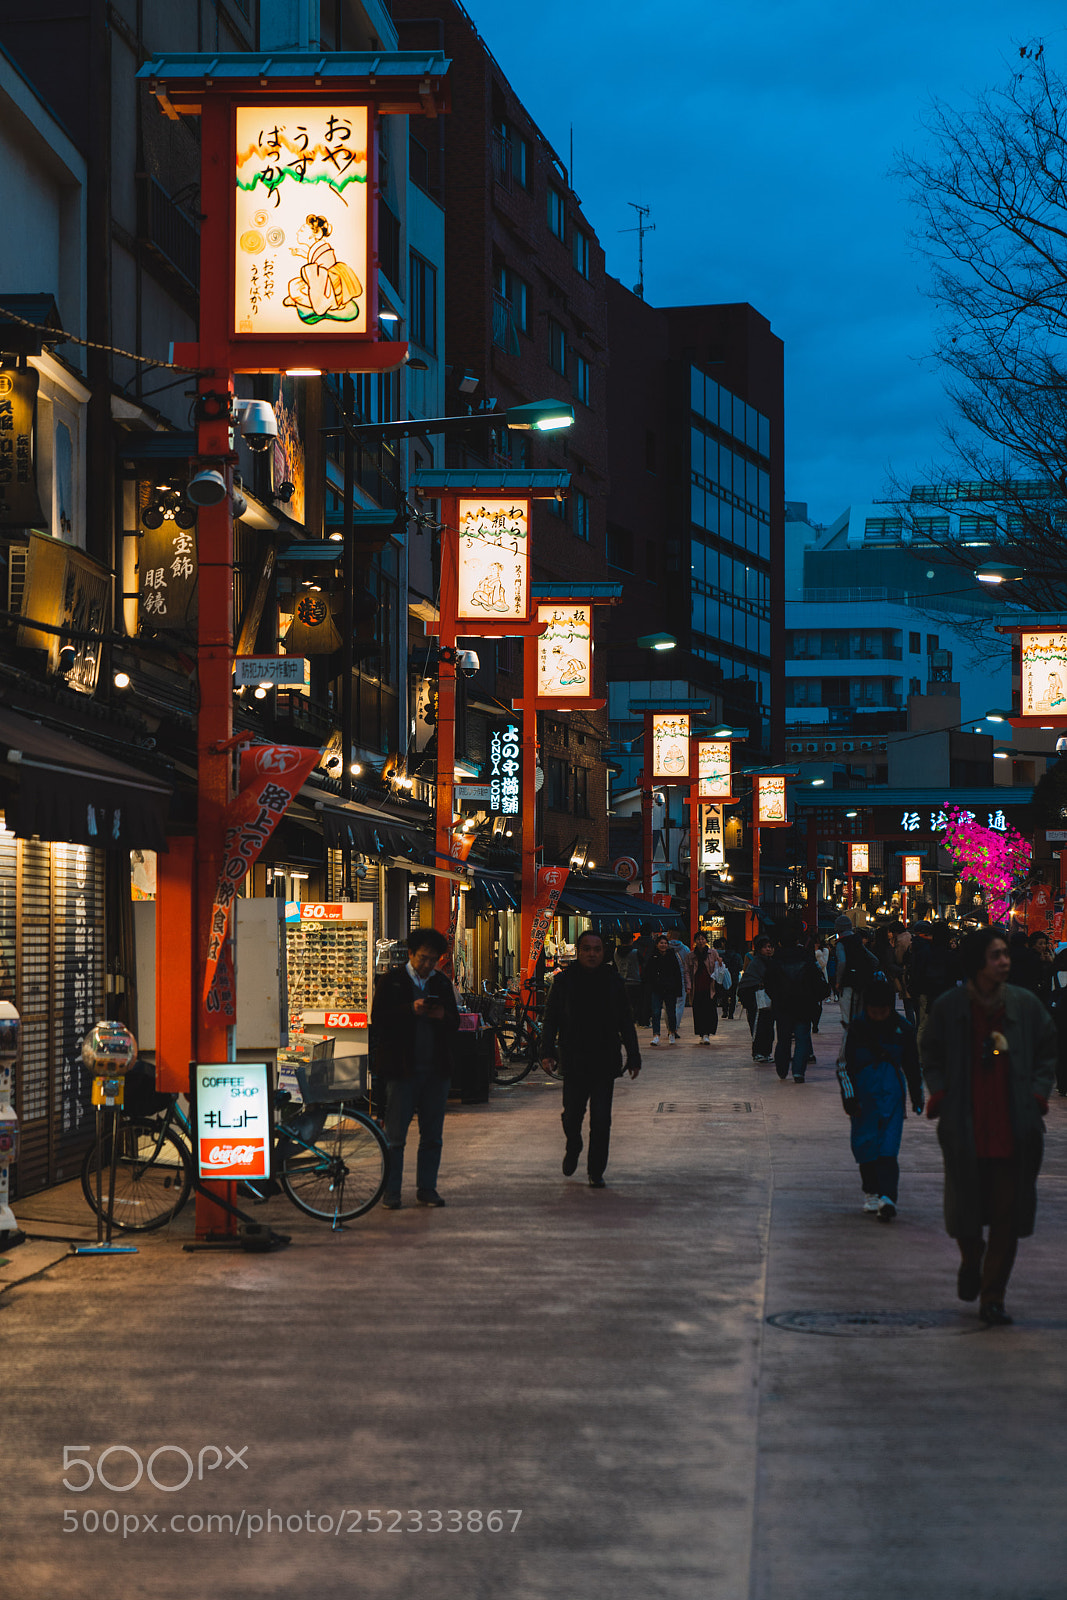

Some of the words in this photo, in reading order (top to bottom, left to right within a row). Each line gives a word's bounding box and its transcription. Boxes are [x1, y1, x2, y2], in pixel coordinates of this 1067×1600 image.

[258, 125, 286, 208] ばっかり
[249, 264, 262, 315] うそばかり
[509, 505, 524, 556] わらう
[170, 532, 194, 580] 宝飾
[143, 567, 168, 615] 眼鏡
[241, 661, 298, 679] 防犯カメラ作動中
[491, 731, 501, 776] YONOYA
[491, 779, 500, 810] COMB
[202, 1077, 244, 1088] COFFEE
[231, 1087, 259, 1097] SHOP
